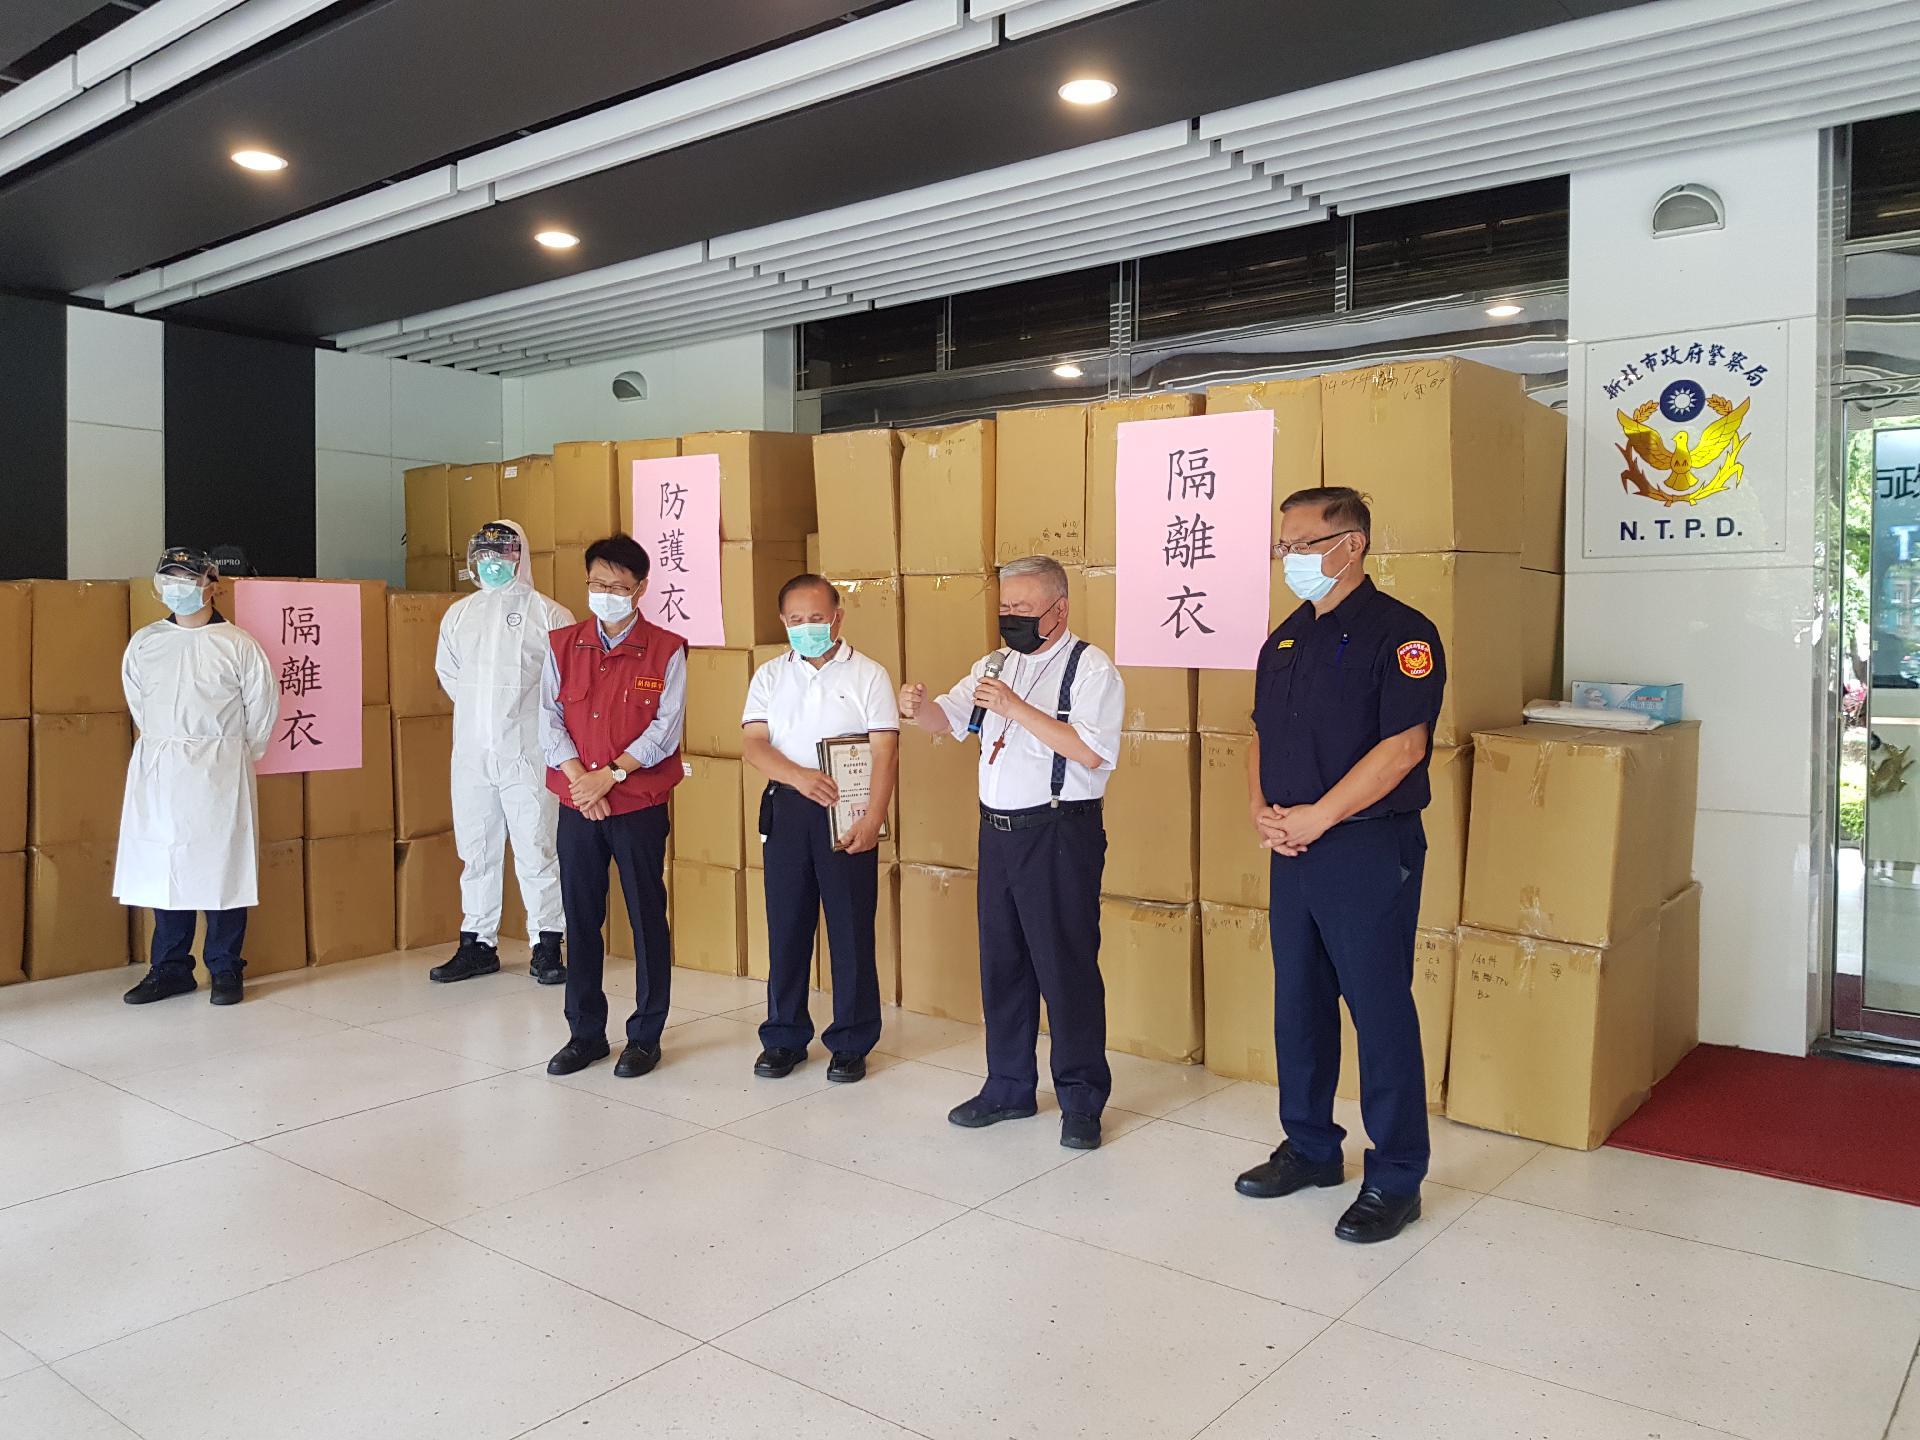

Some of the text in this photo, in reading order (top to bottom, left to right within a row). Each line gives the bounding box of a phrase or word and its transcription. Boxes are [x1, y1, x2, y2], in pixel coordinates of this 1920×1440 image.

[1602, 342, 1769, 400] 新北市政府警察局
[215, 558, 241, 566] MIPRO
[658, 481, 691, 623] 防護衣
[1160, 448, 1216, 639] 隔離衣
[278, 606, 323, 751] 隔離衣
